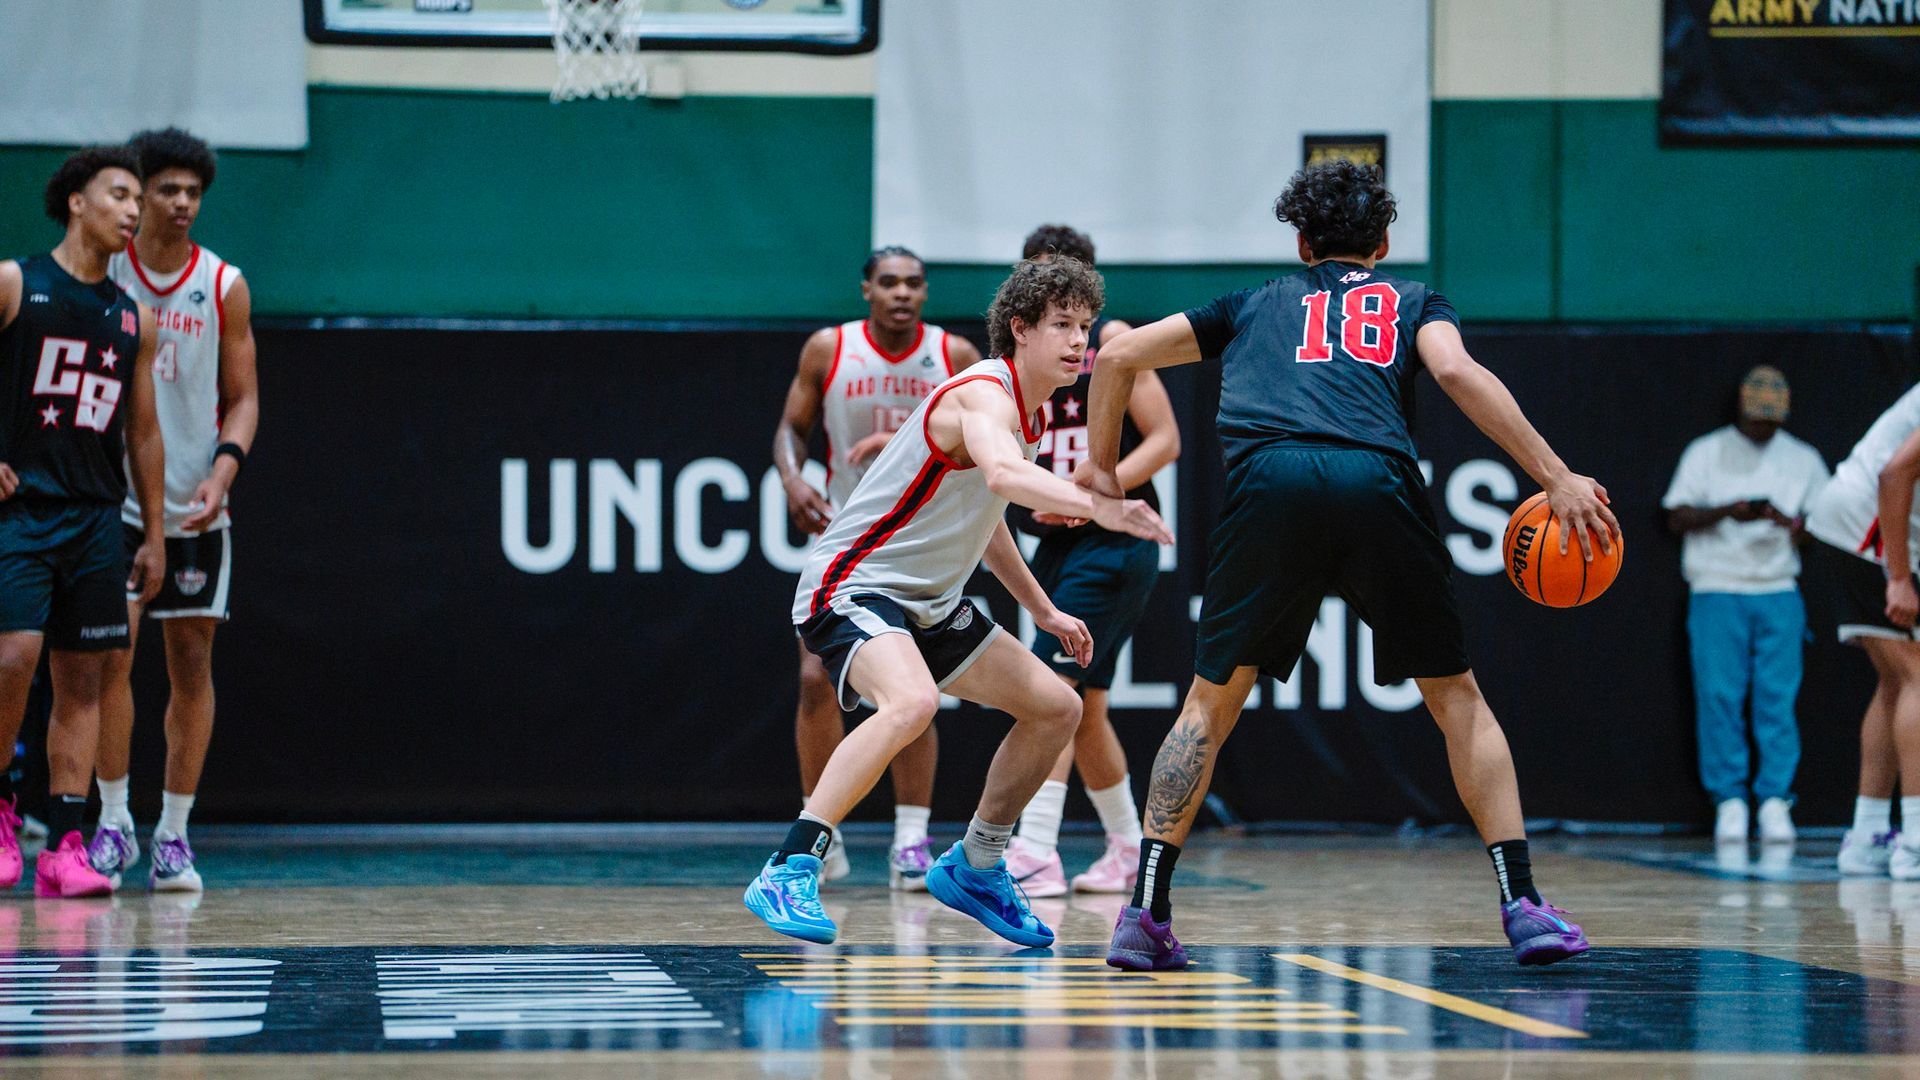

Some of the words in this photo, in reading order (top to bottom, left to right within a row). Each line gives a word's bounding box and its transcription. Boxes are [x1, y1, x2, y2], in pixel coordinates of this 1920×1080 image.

[1708, 0, 1818, 25] ARMY
[151, 306, 207, 342] LIGHT
[1296, 282, 1400, 367] 18
[883, 374, 938, 400] FLIGH
